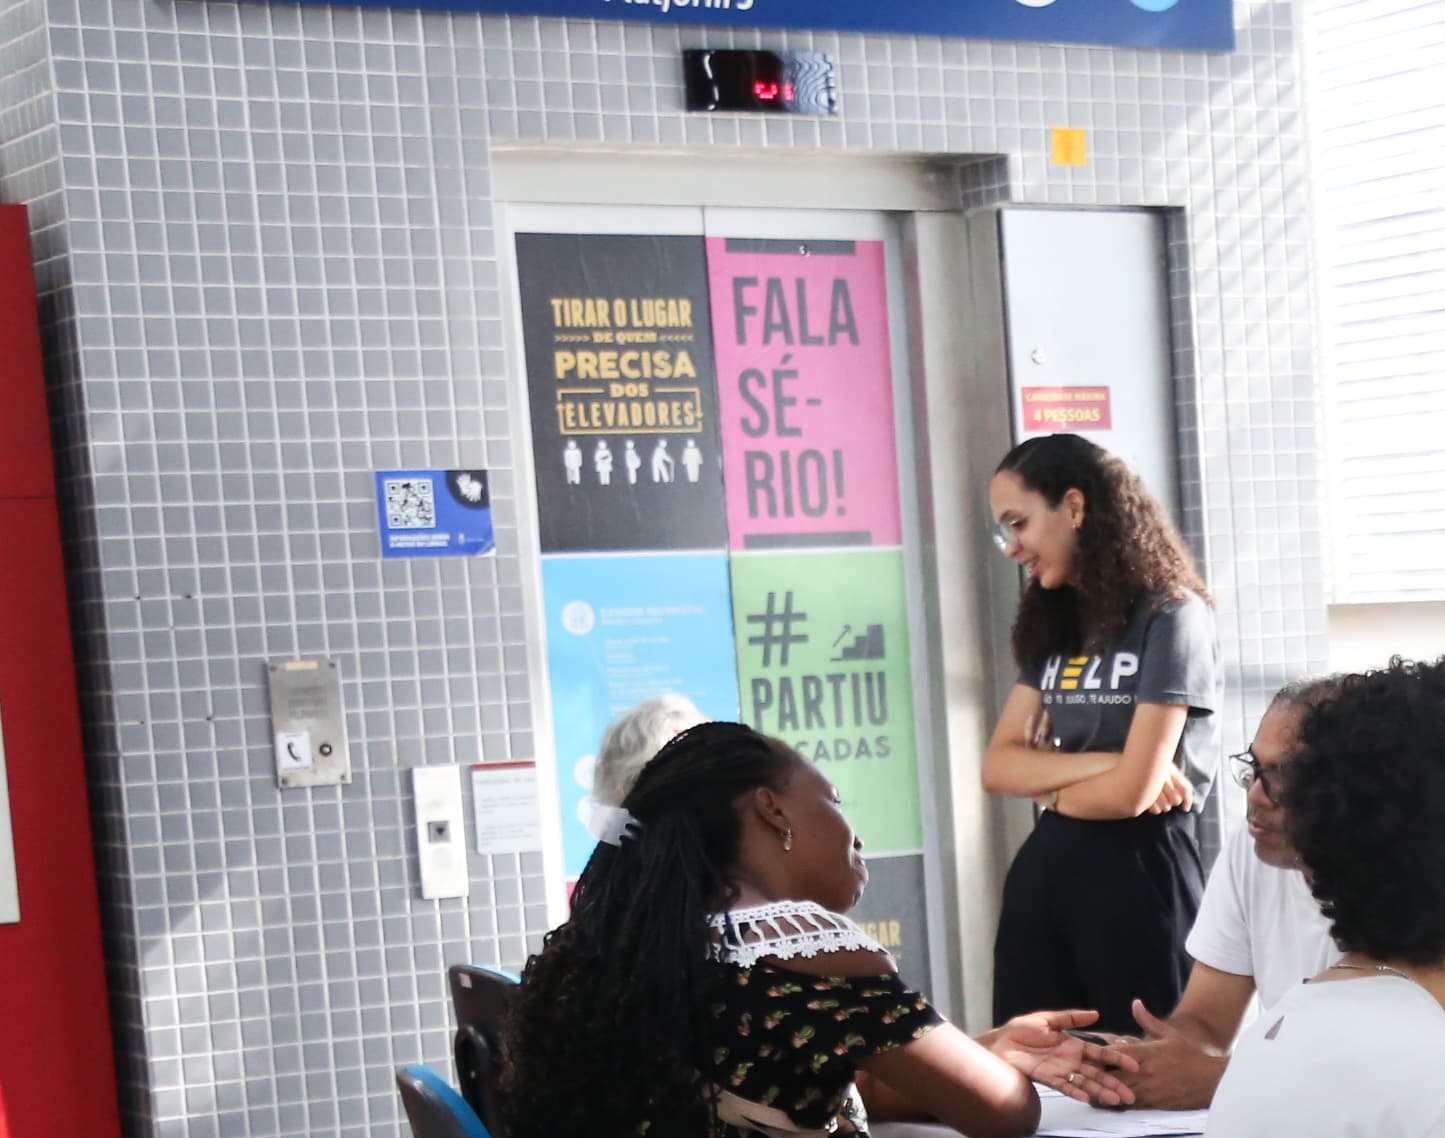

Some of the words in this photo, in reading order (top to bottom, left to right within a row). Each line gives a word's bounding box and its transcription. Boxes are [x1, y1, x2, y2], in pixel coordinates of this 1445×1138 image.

[551, 298, 611, 327] TIRAR
[613, 298, 627, 328] O
[631, 298, 693, 328] LUGAR
[732, 277, 860, 347] FALA
[592, 332, 613, 343] DE
[616, 332, 657, 345] QUEM
[555, 350, 697, 379] PRECISA
[610, 383, 650, 398] DOS
[738, 353, 822, 438] SÉ-
[564, 401, 697, 428] ELEVADORES
[1044, 408, 1101, 422] PESSOAS
[744, 449, 846, 519] RIO!
[1041, 652, 1139, 690] HELP
[751, 671, 889, 734] PARTIU
[794, 736, 891, 762] ADAS
